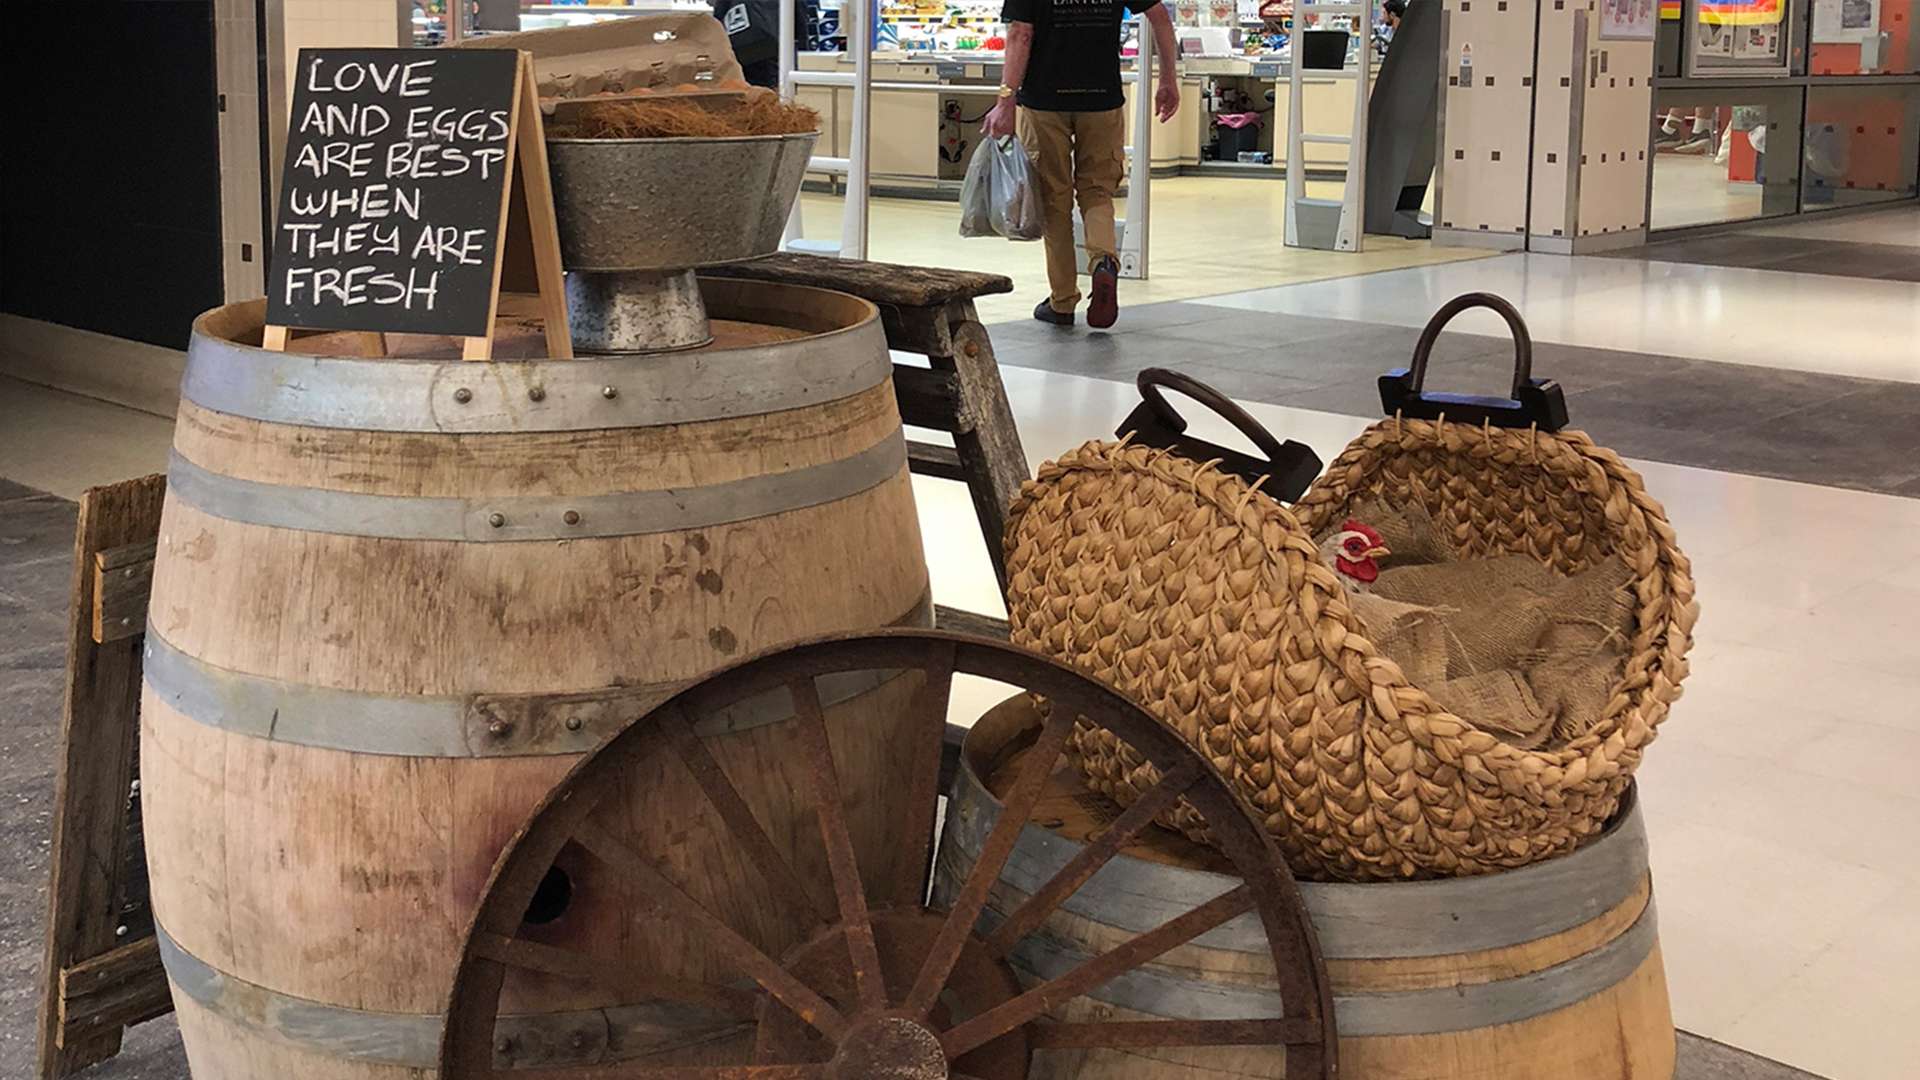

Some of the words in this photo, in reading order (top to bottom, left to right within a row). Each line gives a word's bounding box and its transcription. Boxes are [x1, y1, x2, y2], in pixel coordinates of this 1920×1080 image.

[307, 58, 438, 97] LOVE
[300, 102, 390, 137] AND
[406, 106, 510, 142] EGGS
[294, 142, 375, 179] ARE
[386, 144, 506, 180] BEST
[290, 184, 421, 220] WHEN
[283, 223, 400, 259] THEY
[411, 225, 487, 265] ARE
[285, 266, 439, 310] FRESH
